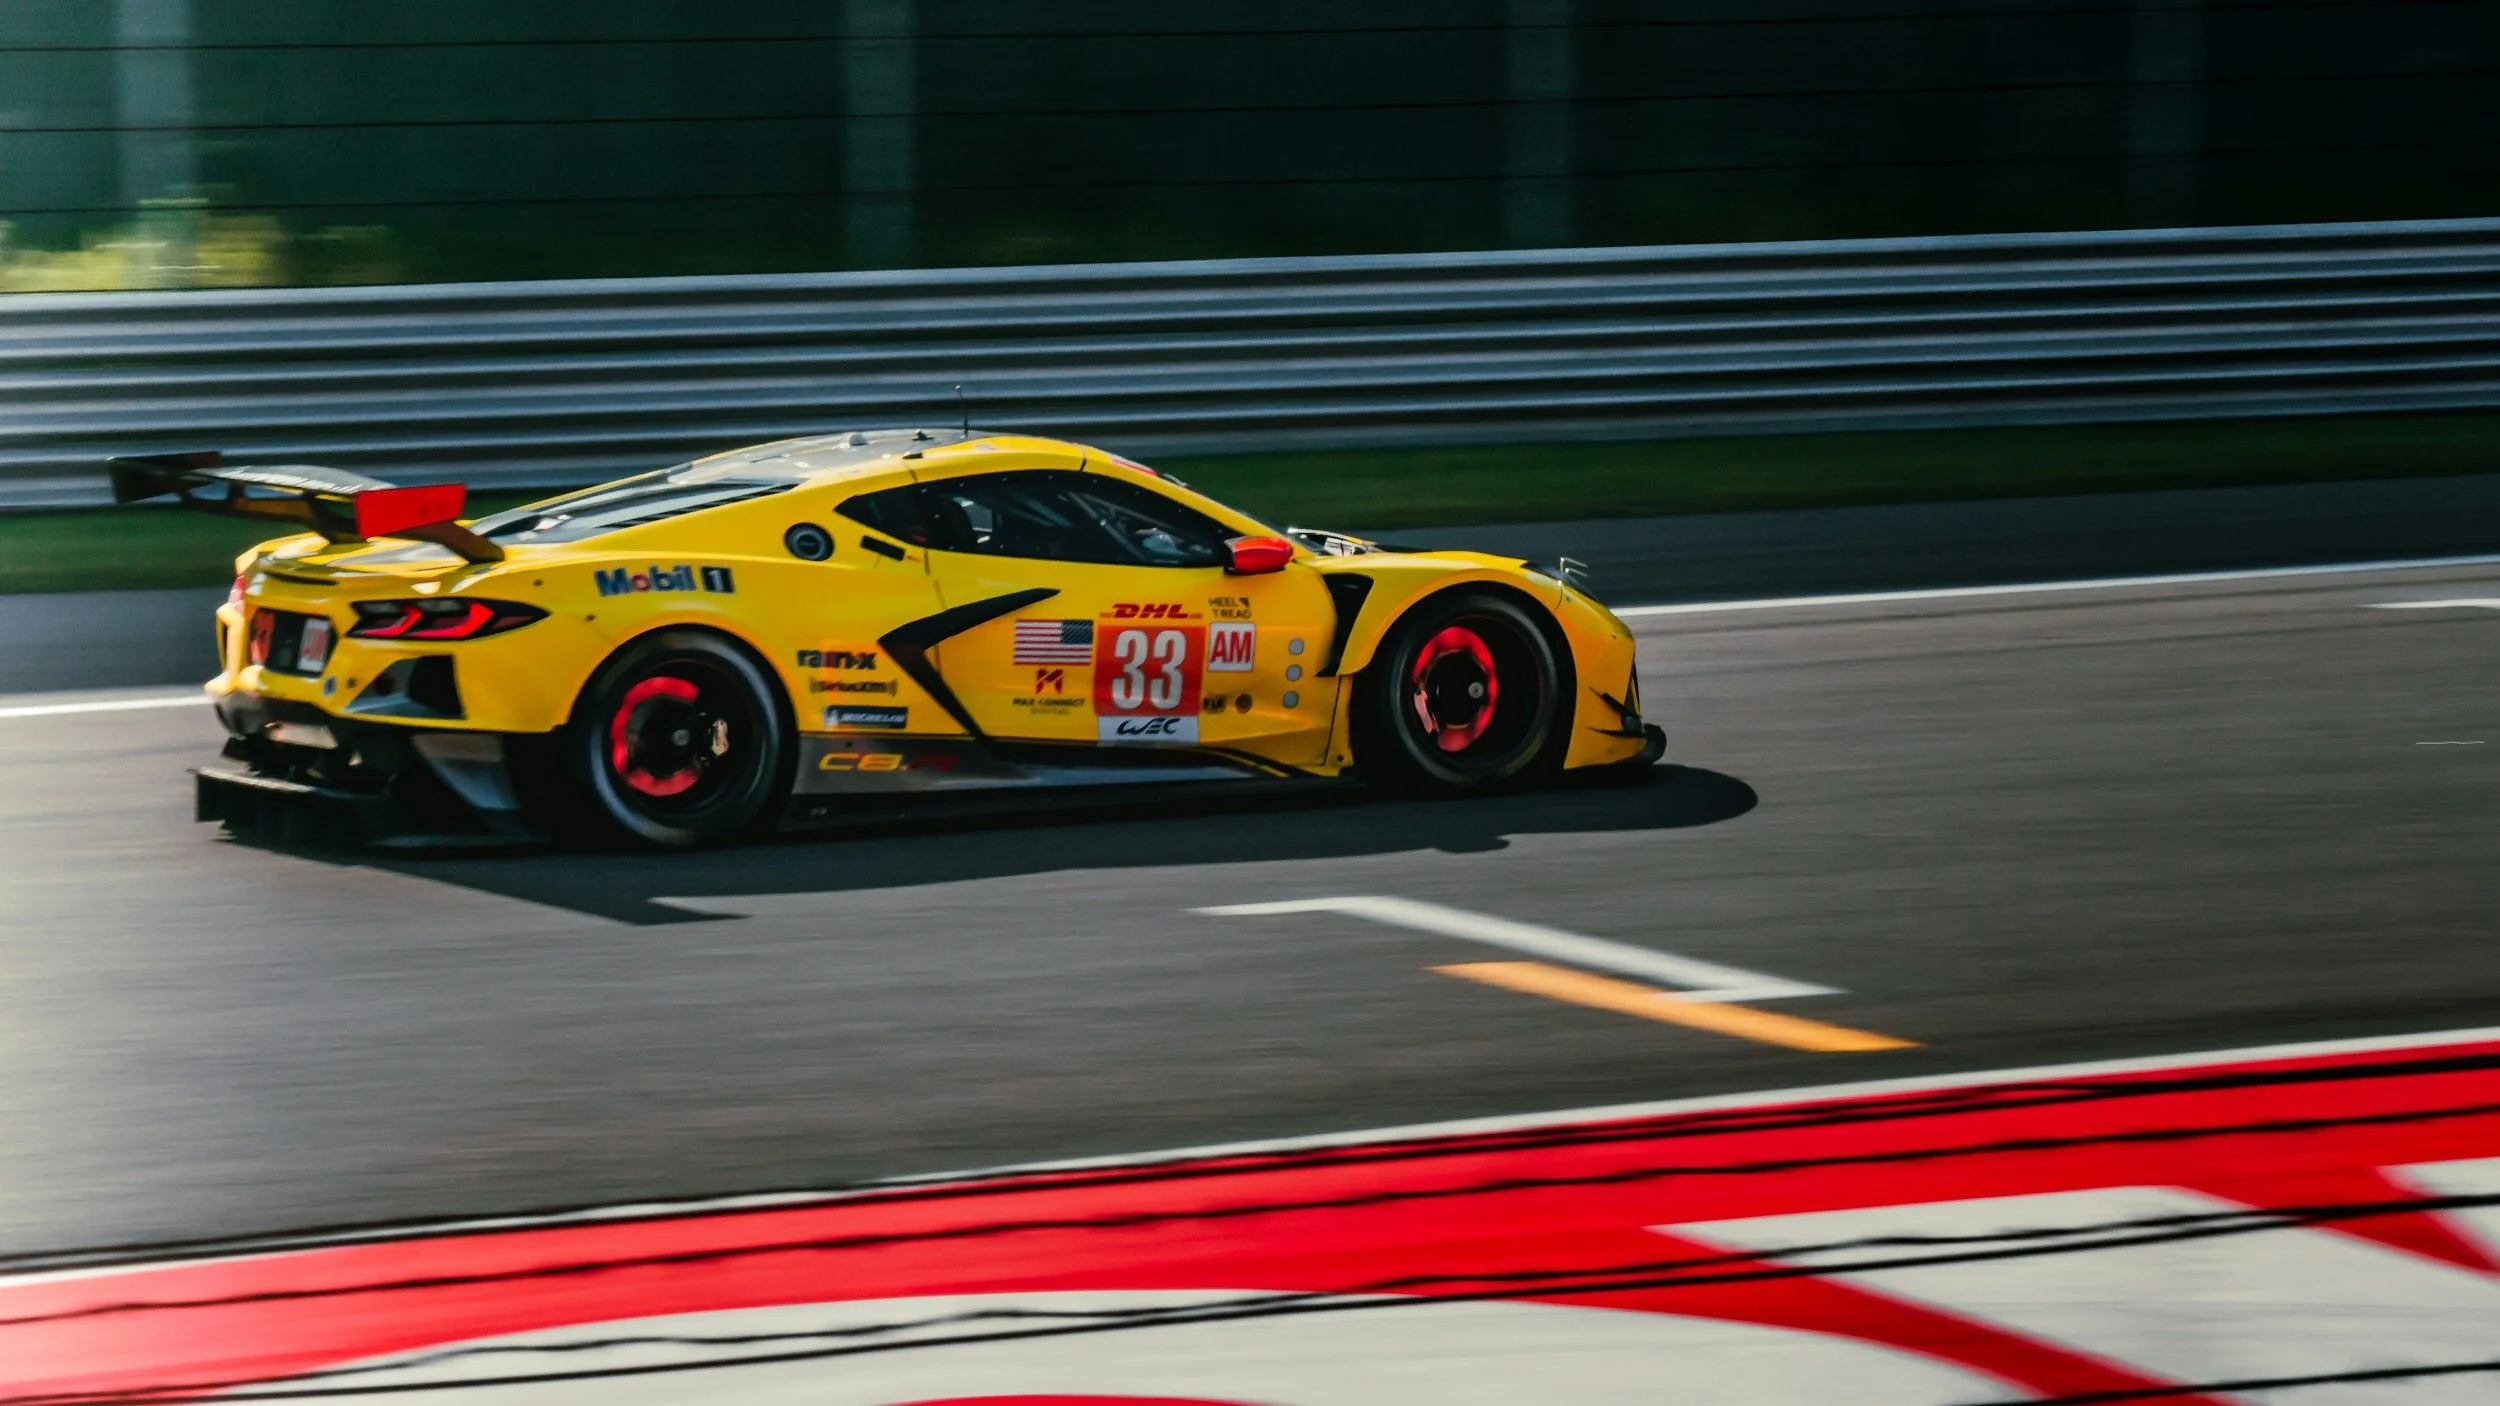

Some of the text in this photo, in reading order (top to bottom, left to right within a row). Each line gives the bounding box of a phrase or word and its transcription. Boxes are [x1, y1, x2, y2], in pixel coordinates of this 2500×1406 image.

[594, 564, 697, 597] Mobil
[1112, 603, 1188, 619] DHL
[1209, 630, 1252, 664] AM
[1111, 629, 1187, 710] 33
[1117, 717, 1180, 735] WEC
